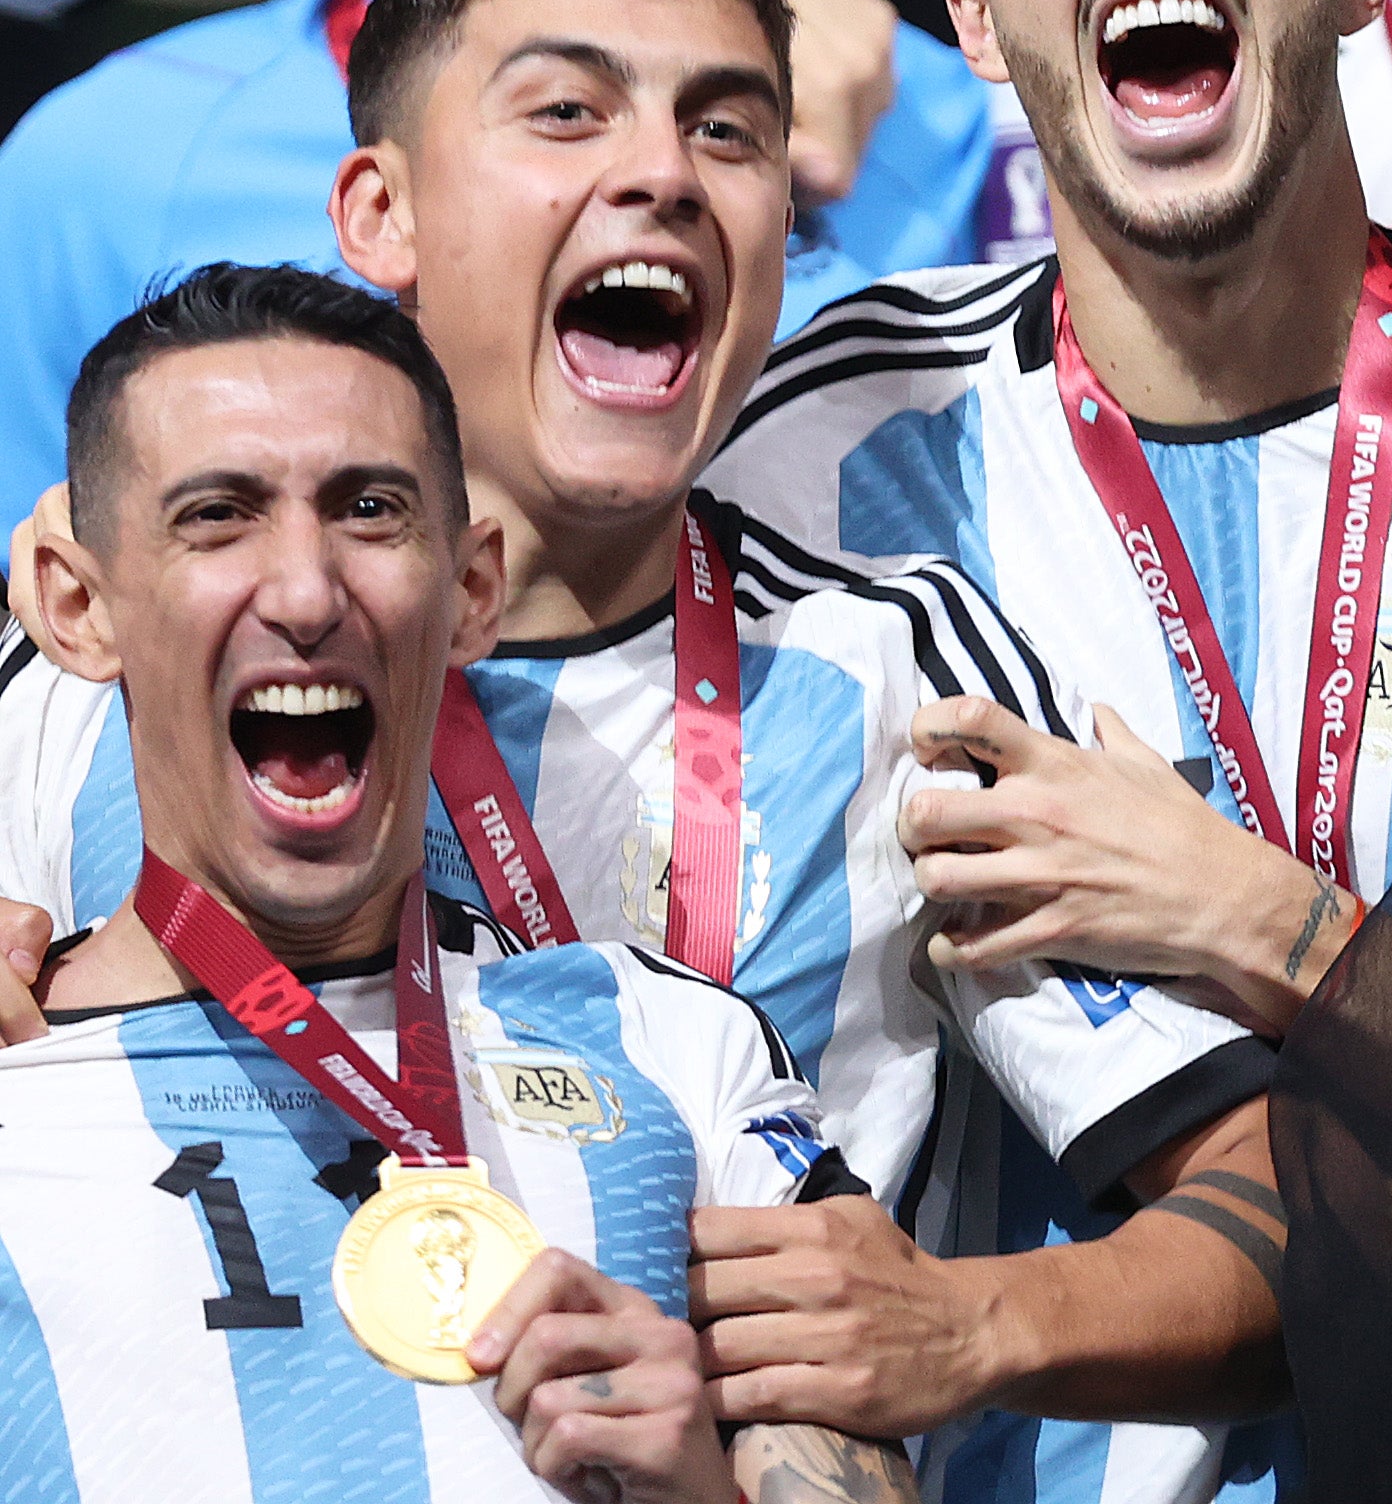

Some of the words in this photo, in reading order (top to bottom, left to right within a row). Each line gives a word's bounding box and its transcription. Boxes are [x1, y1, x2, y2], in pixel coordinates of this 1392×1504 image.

[1350, 413, 1383, 481] FIFA
[1337, 481, 1373, 593] WORLD
[1331, 595, 1358, 656] CUP
[474, 794, 516, 863] FIFA
[511, 1063, 591, 1111] AFA
